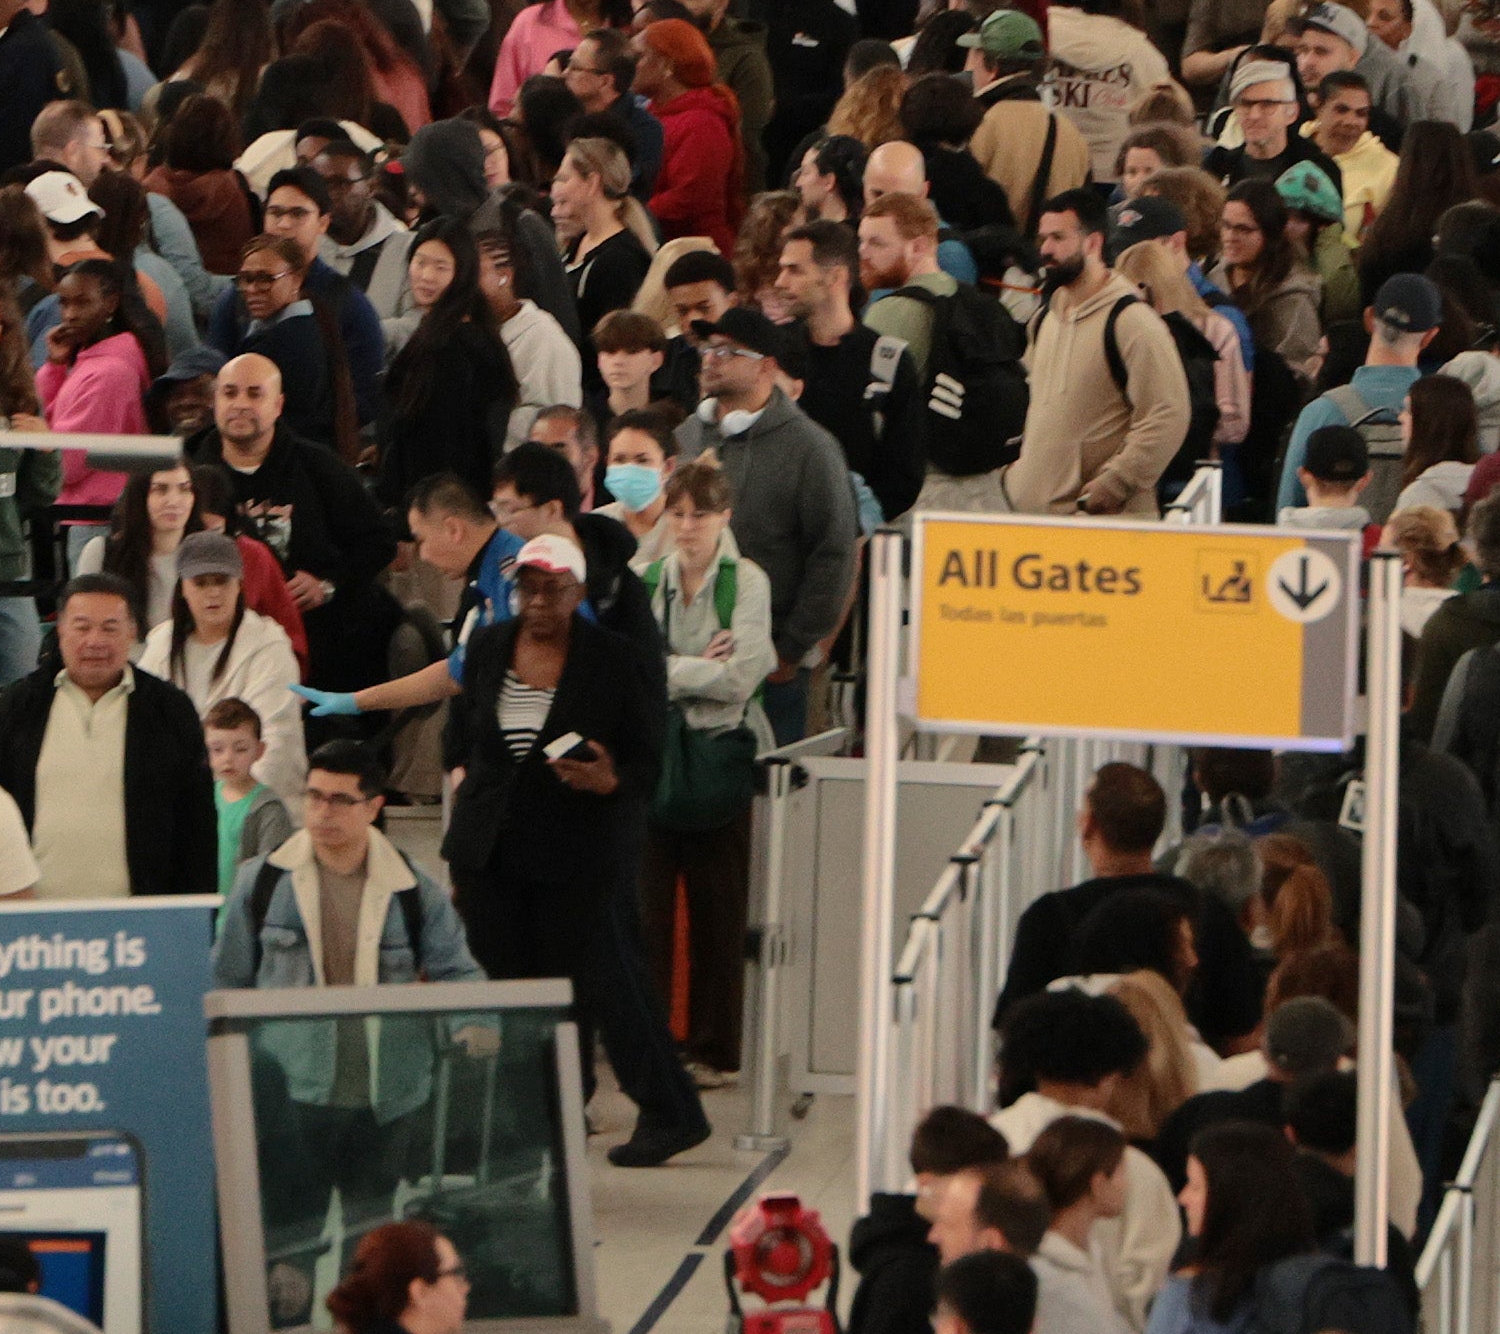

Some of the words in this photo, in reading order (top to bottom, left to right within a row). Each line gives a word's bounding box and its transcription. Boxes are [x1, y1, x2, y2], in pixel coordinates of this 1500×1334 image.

[939, 550, 997, 587] All
[1011, 553, 1141, 595] Gates
[115, 932, 146, 967] is
[40, 981, 161, 1023] phone.
[29, 1033, 117, 1073] your
[0, 1078, 30, 1114] is
[35, 1080, 104, 1113] too.
